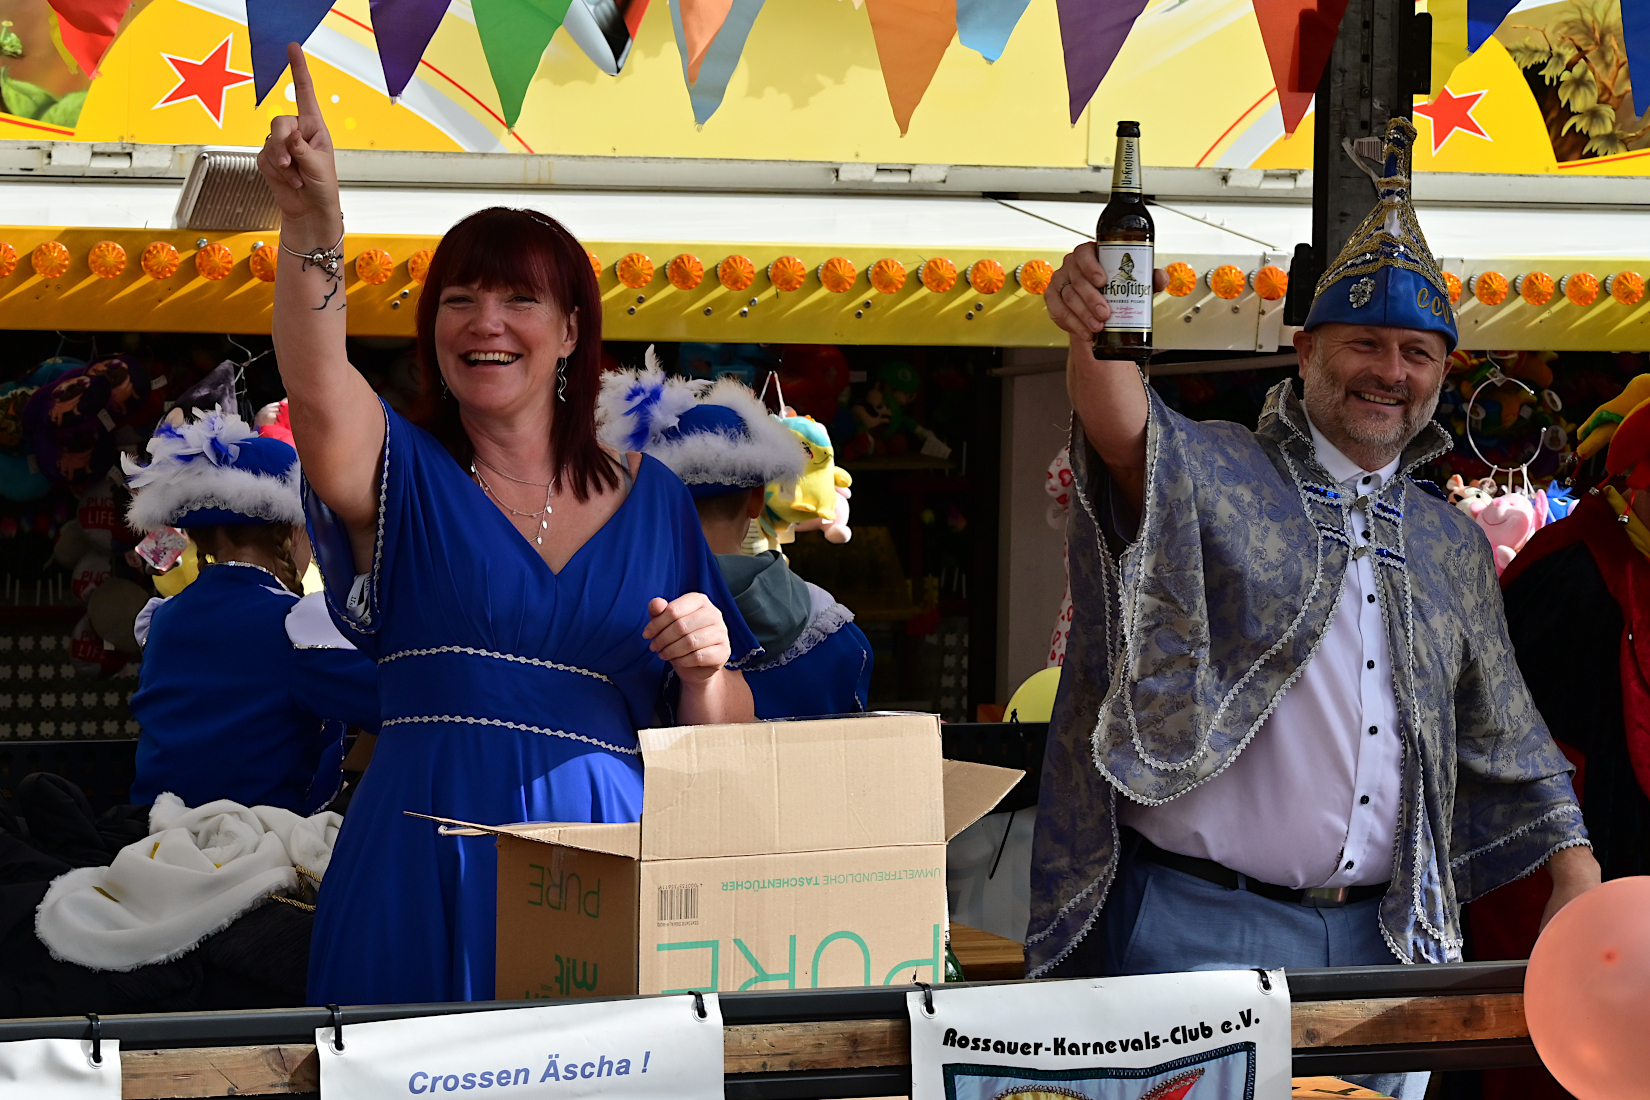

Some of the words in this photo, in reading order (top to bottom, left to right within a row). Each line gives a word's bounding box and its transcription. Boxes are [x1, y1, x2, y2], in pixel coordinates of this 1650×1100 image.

[88, 510, 115, 527] LIFE
[527, 863, 601, 919] PURE
[721, 876, 820, 893] TASCHENTÜCHER
[822, 867, 941, 886] UMWELTFREUNDLICHE
[942, 1021, 1214, 1056] Rossauer-Karnevals-Club
[1220, 1008, 1261, 1035] e.V.
[408, 1067, 531, 1095] Crossen
[539, 1053, 632, 1084] Äscha
[641, 1050, 651, 1074] !
